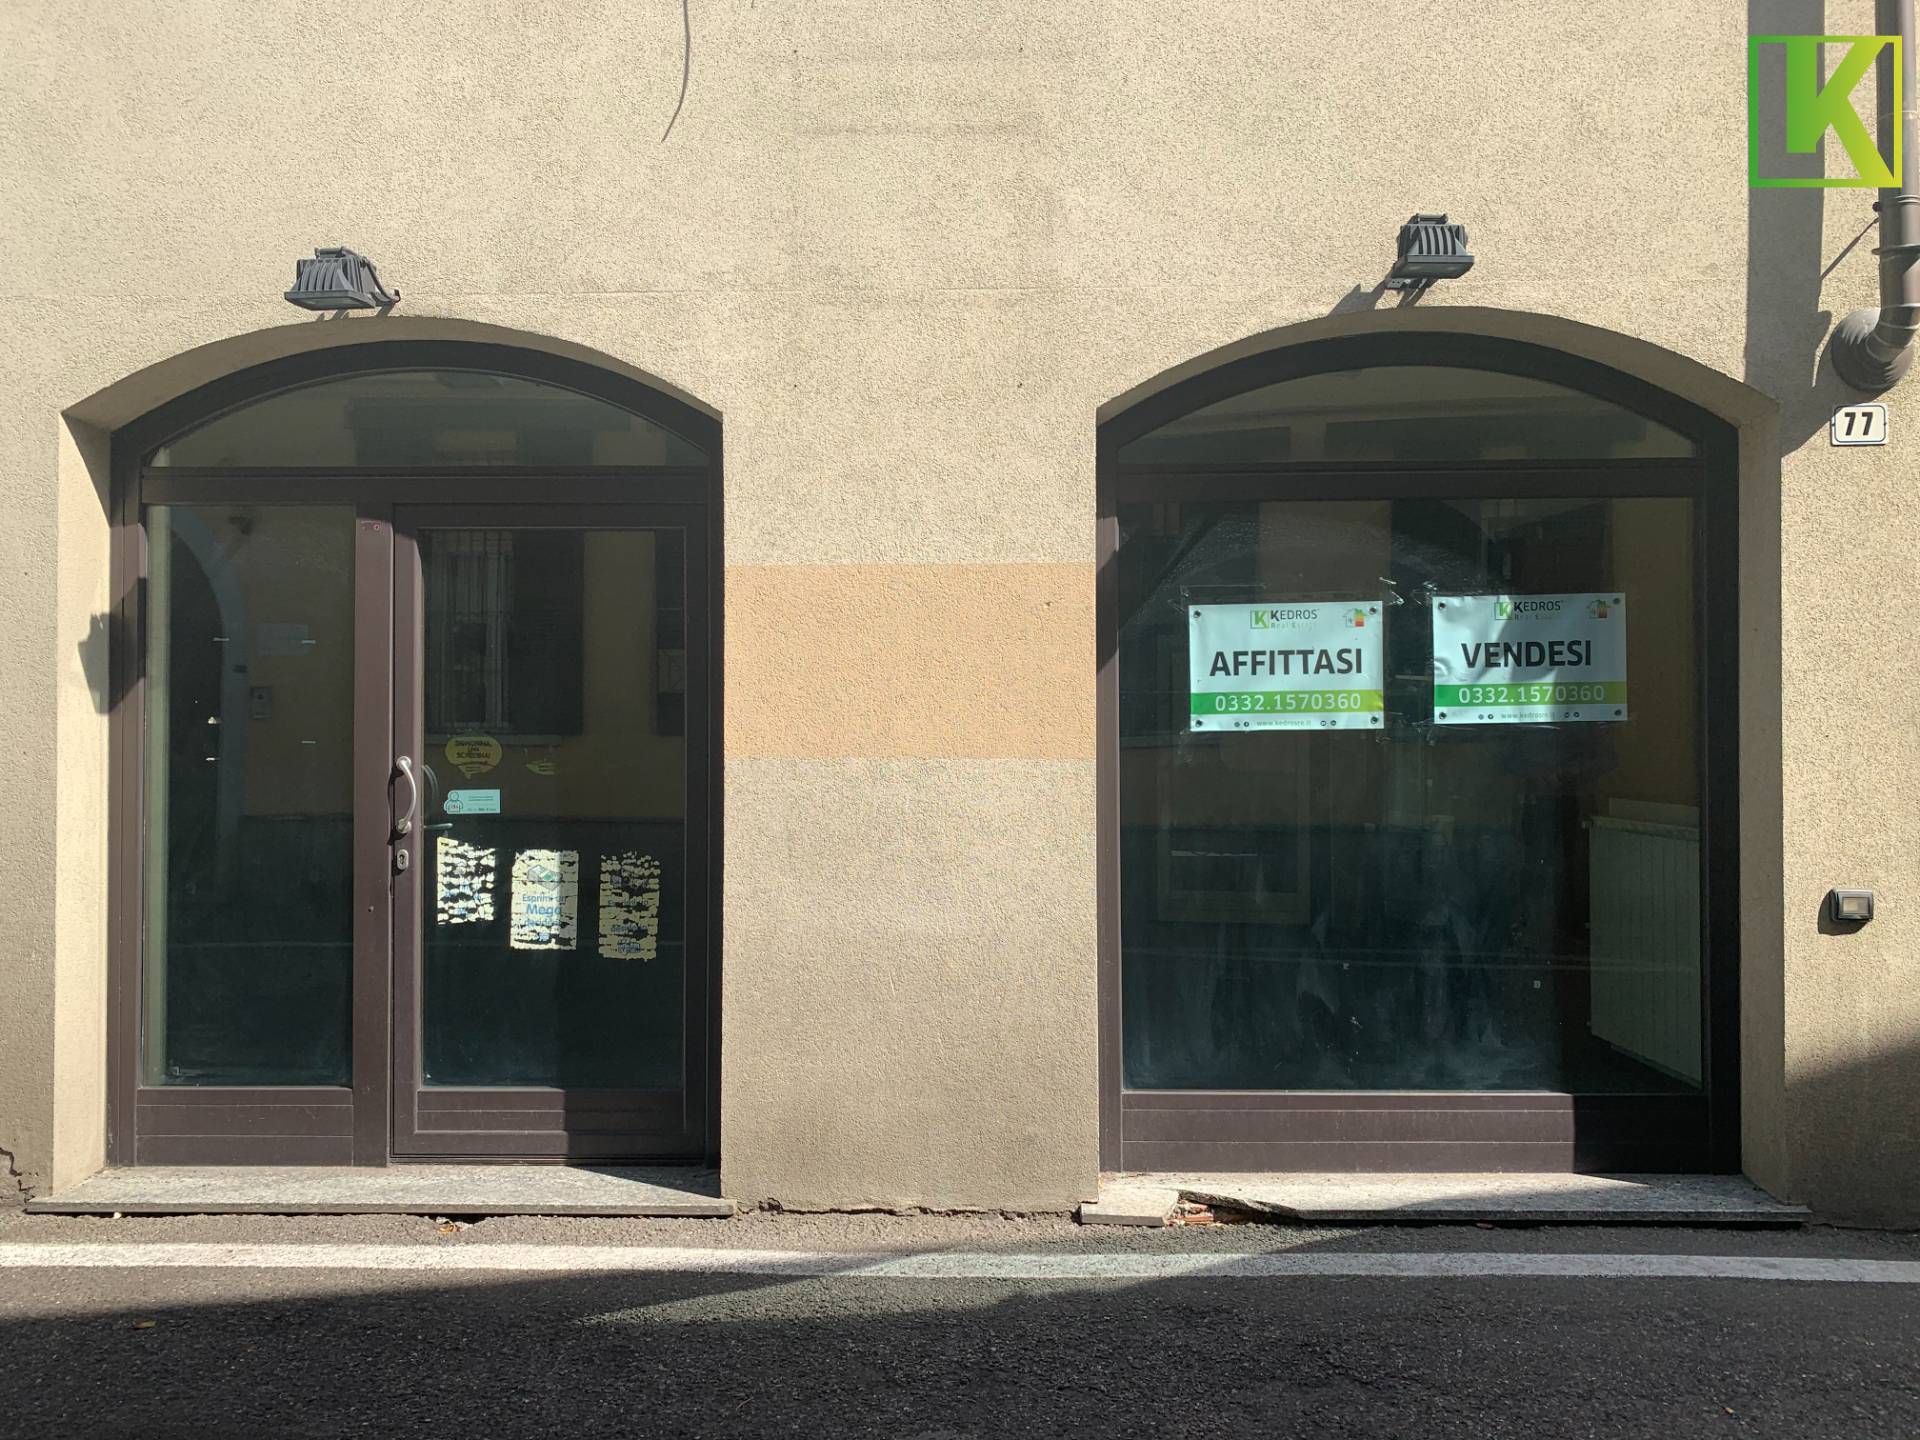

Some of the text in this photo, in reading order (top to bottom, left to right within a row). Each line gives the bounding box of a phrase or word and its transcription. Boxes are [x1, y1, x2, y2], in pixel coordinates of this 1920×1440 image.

[1844, 412, 1873, 436] 77
[1270, 608, 1318, 621] KEDROS
[1513, 600, 1561, 613] KEDROS
[1209, 648, 1362, 676] AFFITTASI
[1461, 640, 1591, 668] VENDESI
[1215, 693, 1361, 711] 0332.1570360
[1458, 685, 1605, 704] 0332.1570360
